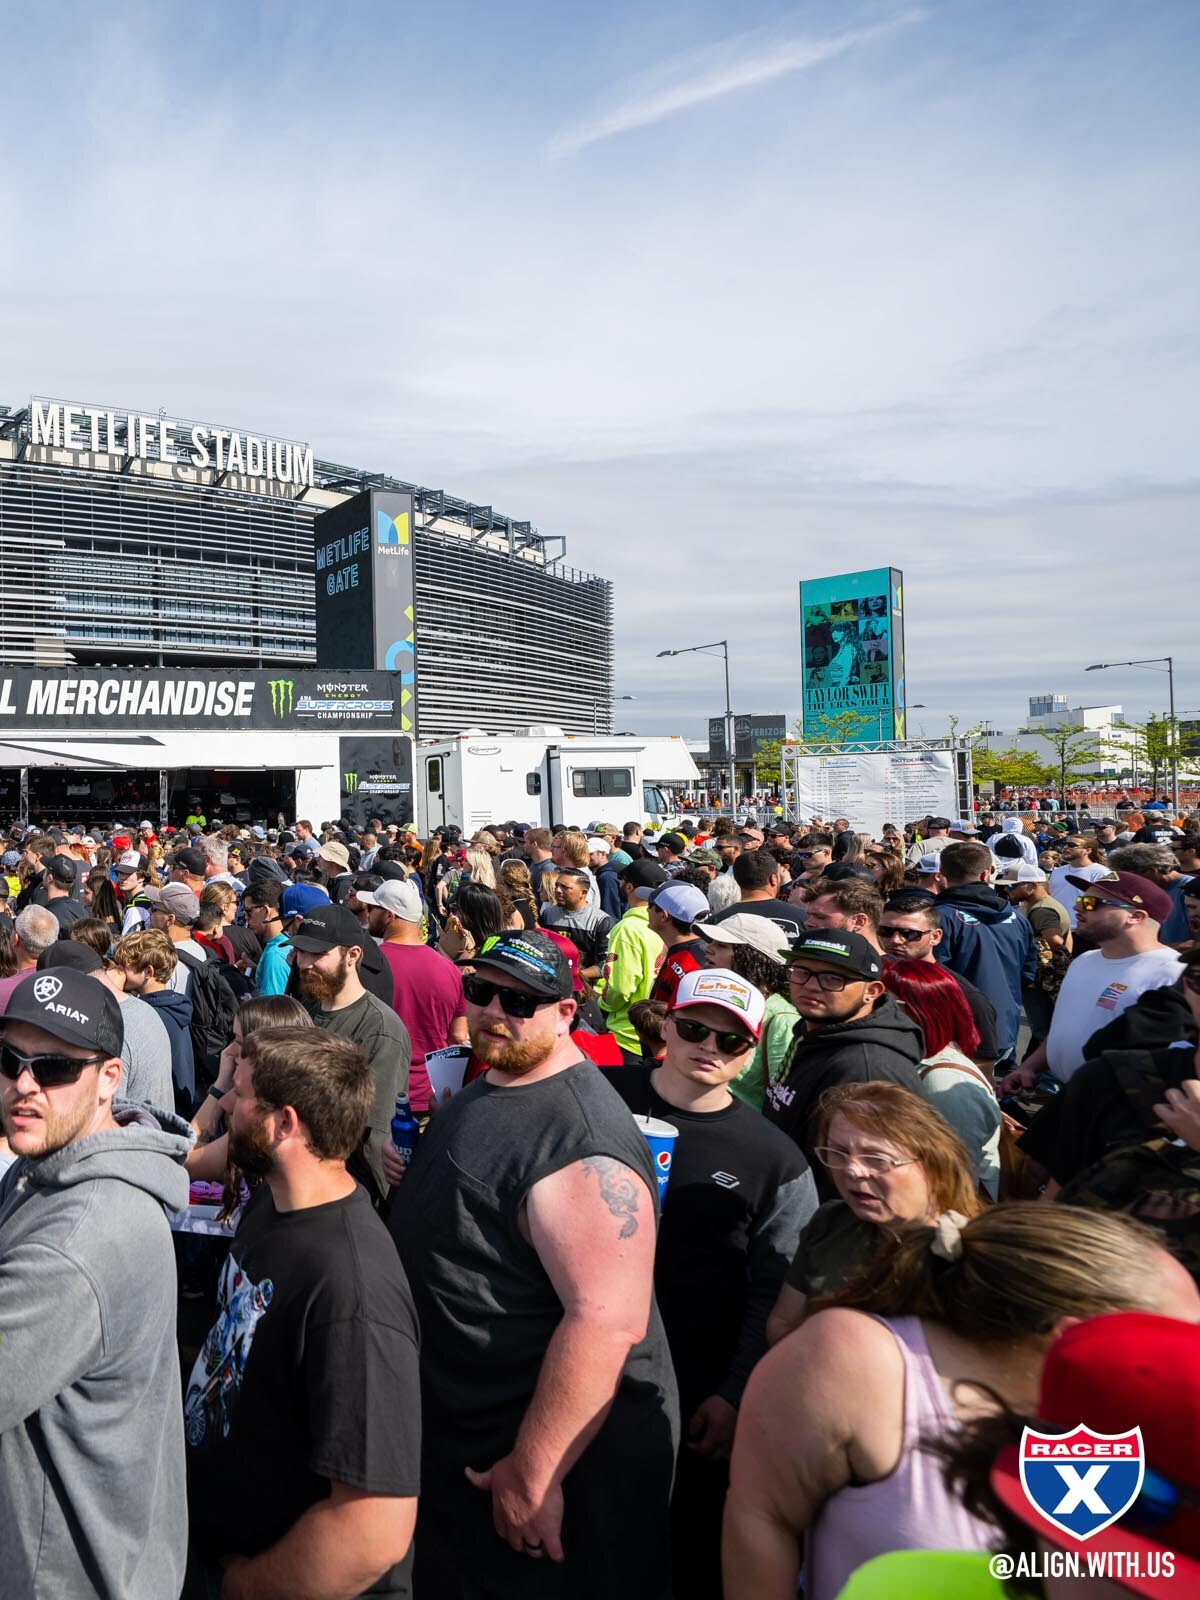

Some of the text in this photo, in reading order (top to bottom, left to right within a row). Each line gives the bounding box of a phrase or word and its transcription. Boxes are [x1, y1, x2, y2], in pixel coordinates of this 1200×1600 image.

[31, 400, 314, 487] METLIFE STADIUM
[317, 527, 369, 570] METLIFE
[378, 546, 409, 556] MetLife
[327, 564, 359, 596] GATE
[317, 682, 368, 693] MONSTER
[806, 683, 889, 703] TAYLOR SWIFT
[26, 679, 256, 717] MERCHANDISE
[296, 700, 394, 711] SUPERCROSS
[806, 698, 889, 711] THE ERAS TOUR
[317, 711, 373, 719] CHAMPIONSHIP
[45, 1002, 89, 1025] ARIAT
[393, 1144, 412, 1156] UD
